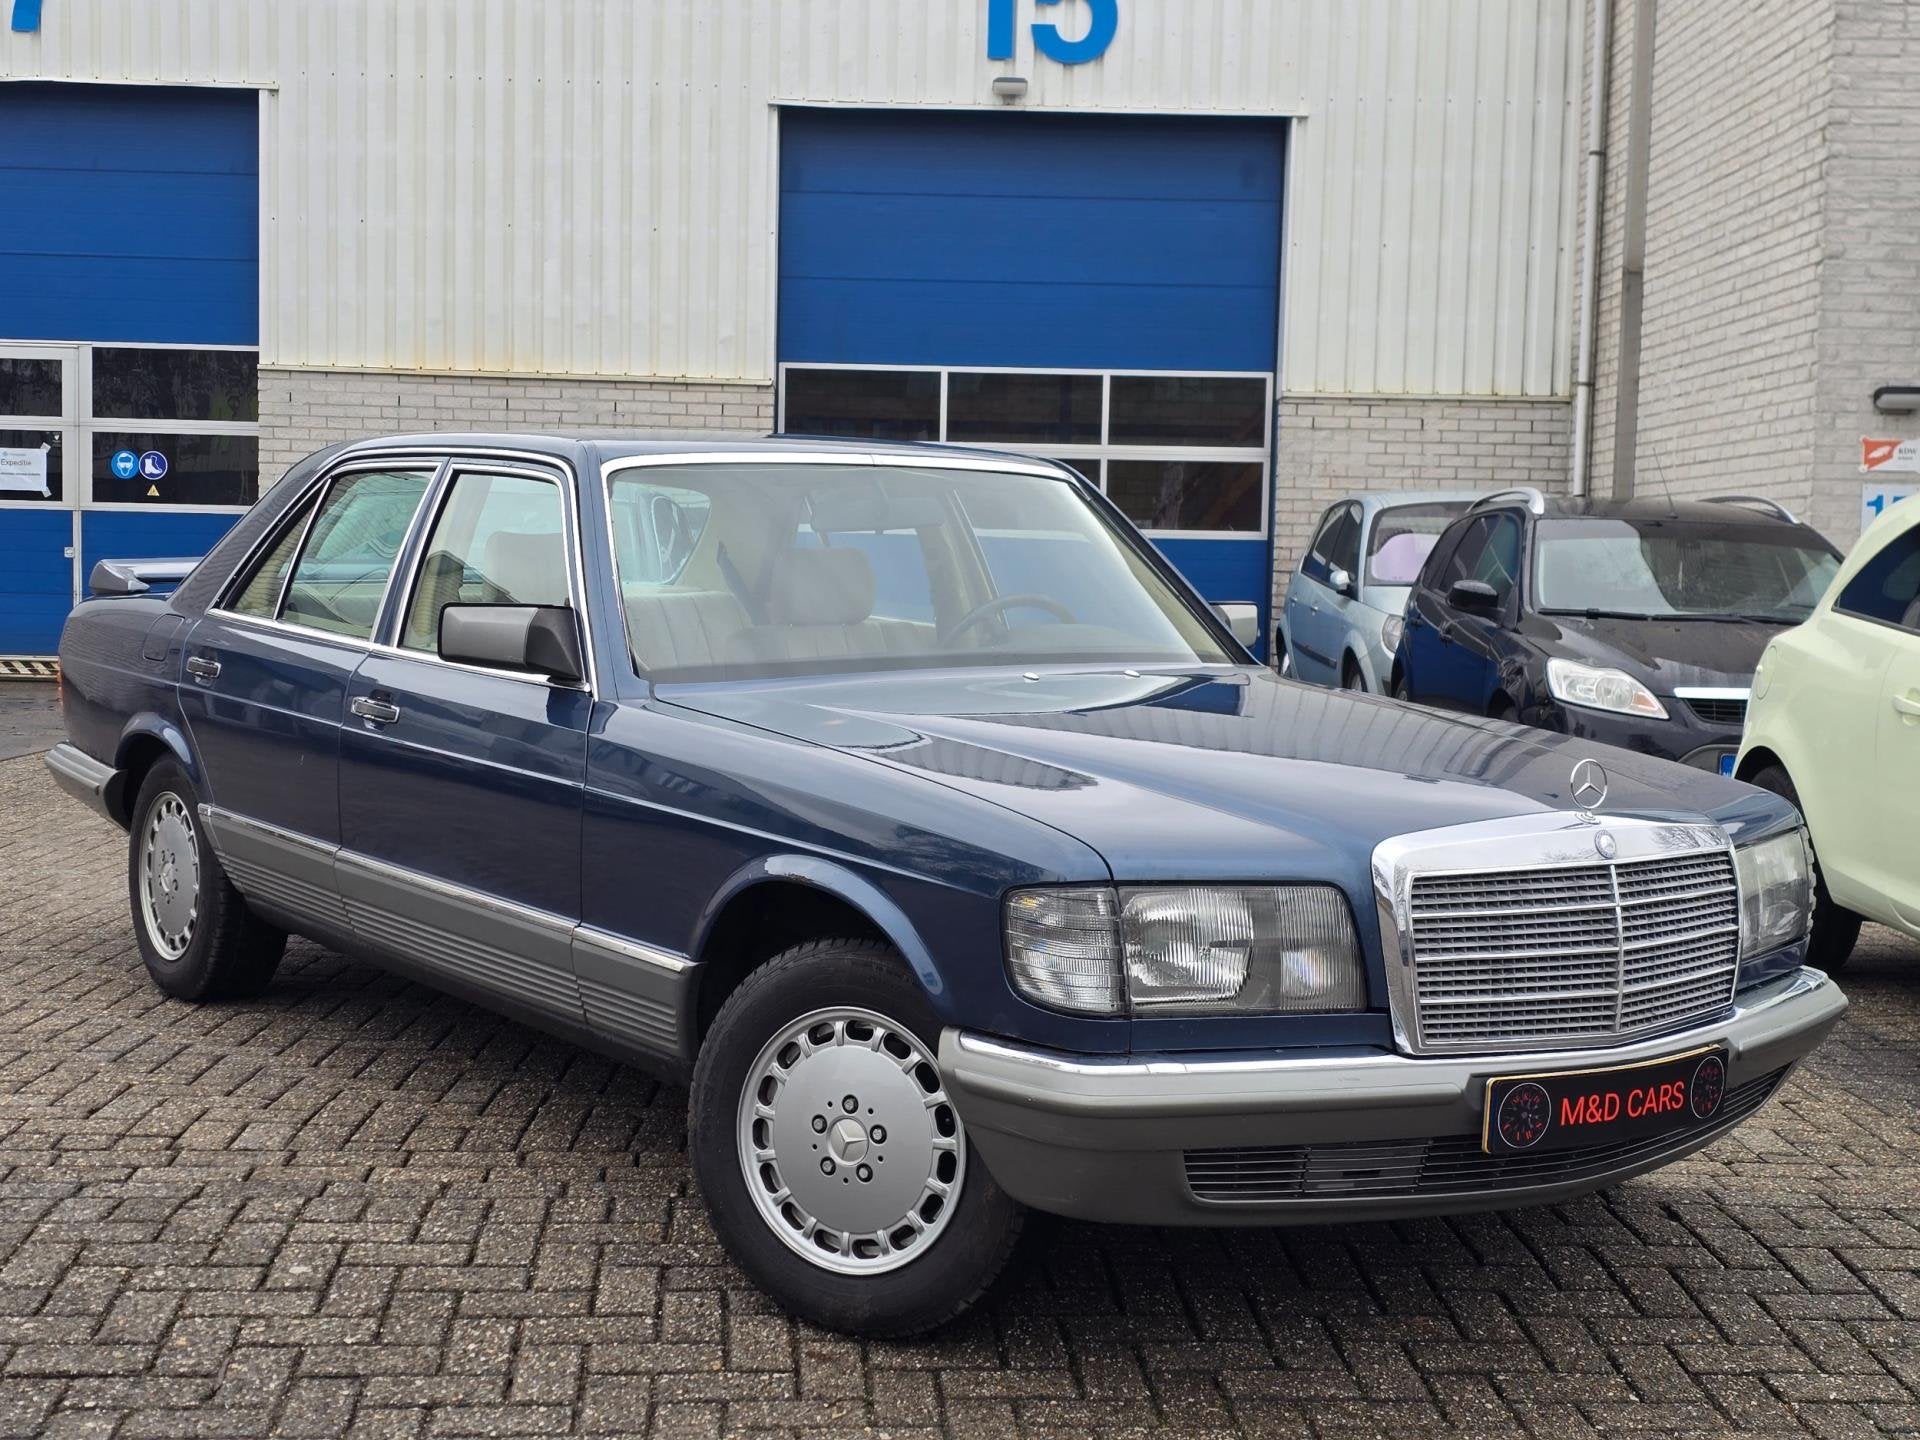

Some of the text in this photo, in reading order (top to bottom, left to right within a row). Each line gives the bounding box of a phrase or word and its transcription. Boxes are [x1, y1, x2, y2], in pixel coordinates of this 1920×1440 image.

[1, 459, 32, 467] Expeditie
[1560, 1093, 1620, 1126] M&D
[1627, 1081, 1685, 1118] CARS
